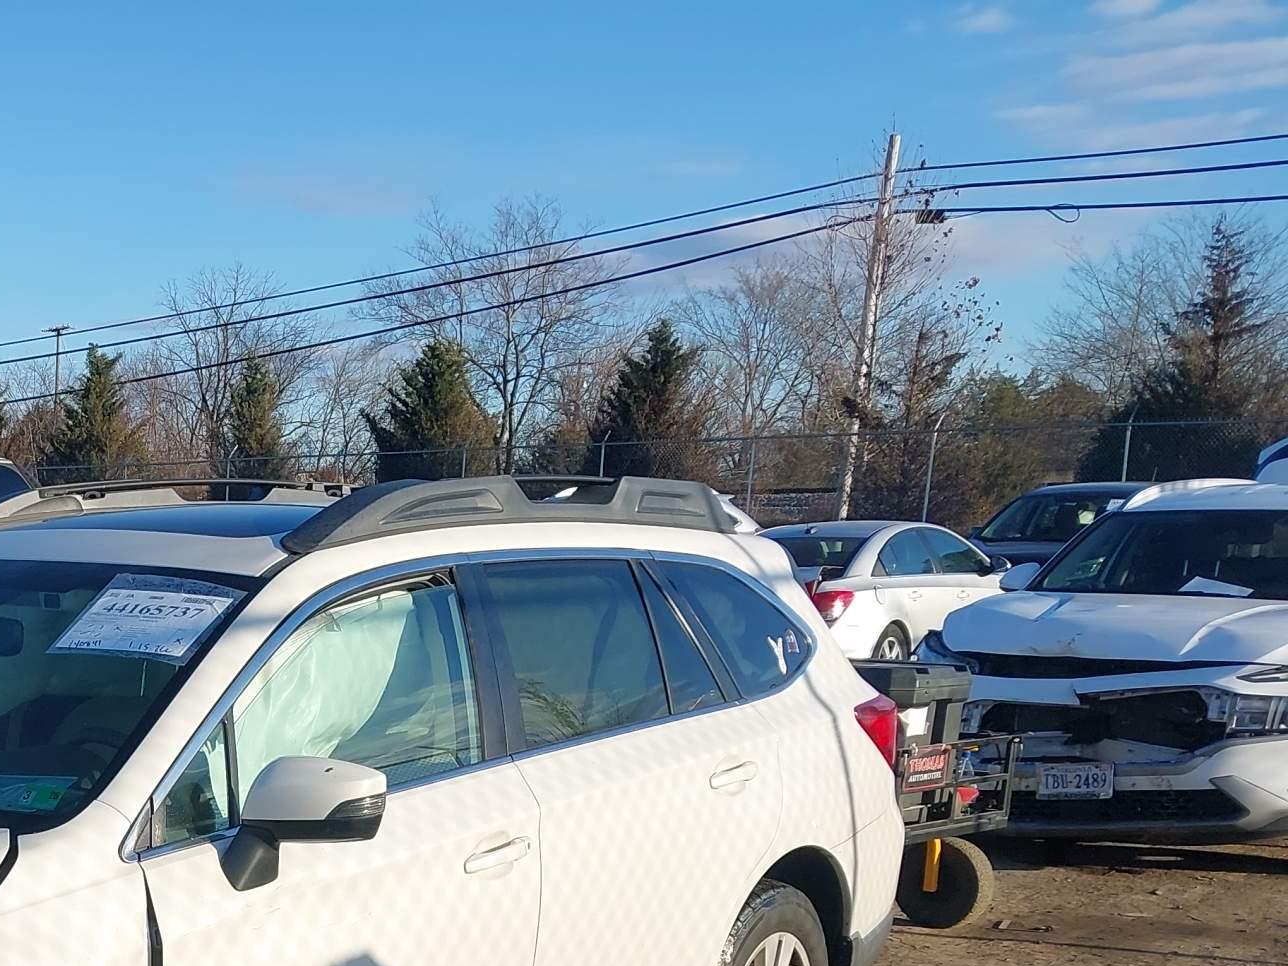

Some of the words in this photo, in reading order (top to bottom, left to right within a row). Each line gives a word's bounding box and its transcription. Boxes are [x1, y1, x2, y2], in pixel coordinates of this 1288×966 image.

[103, 602, 206, 619] 44165737
[909, 754, 945, 773] THOMAS
[1044, 772, 1107, 790] TBU-2489
